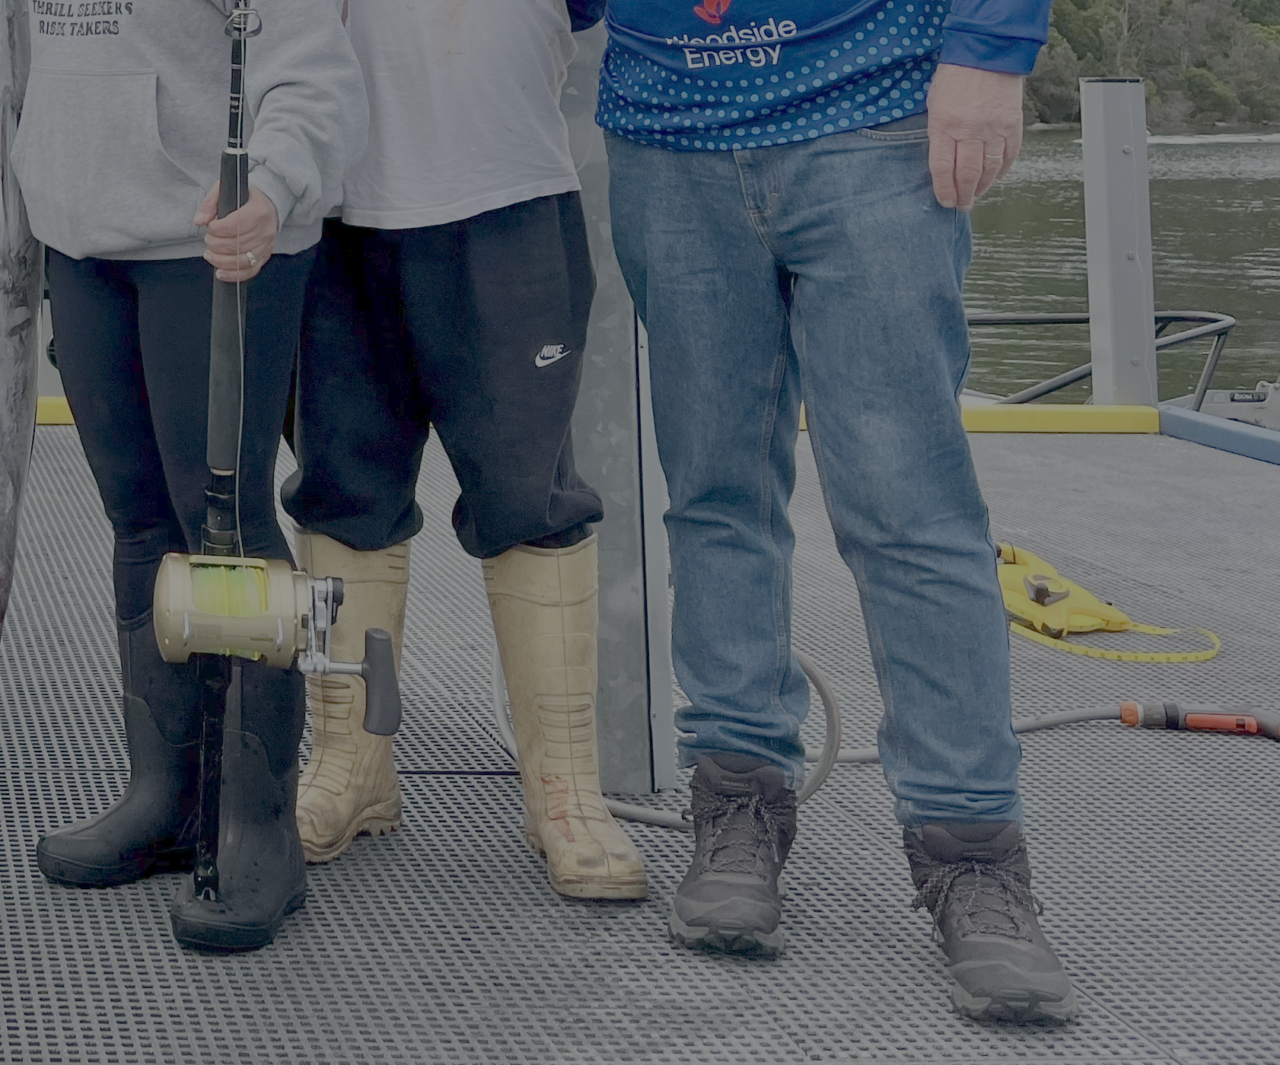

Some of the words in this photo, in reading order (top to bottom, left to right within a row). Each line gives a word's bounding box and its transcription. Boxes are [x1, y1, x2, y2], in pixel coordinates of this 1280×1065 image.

[32, 0, 74, 17] THRILL
[77, 1, 133, 17] SEEKERS
[39, 20, 66, 36] RISK
[70, 21, 120, 36] TAKERS
[683, 44, 781, 69] Energy
[540, 344, 565, 357] NIKE
